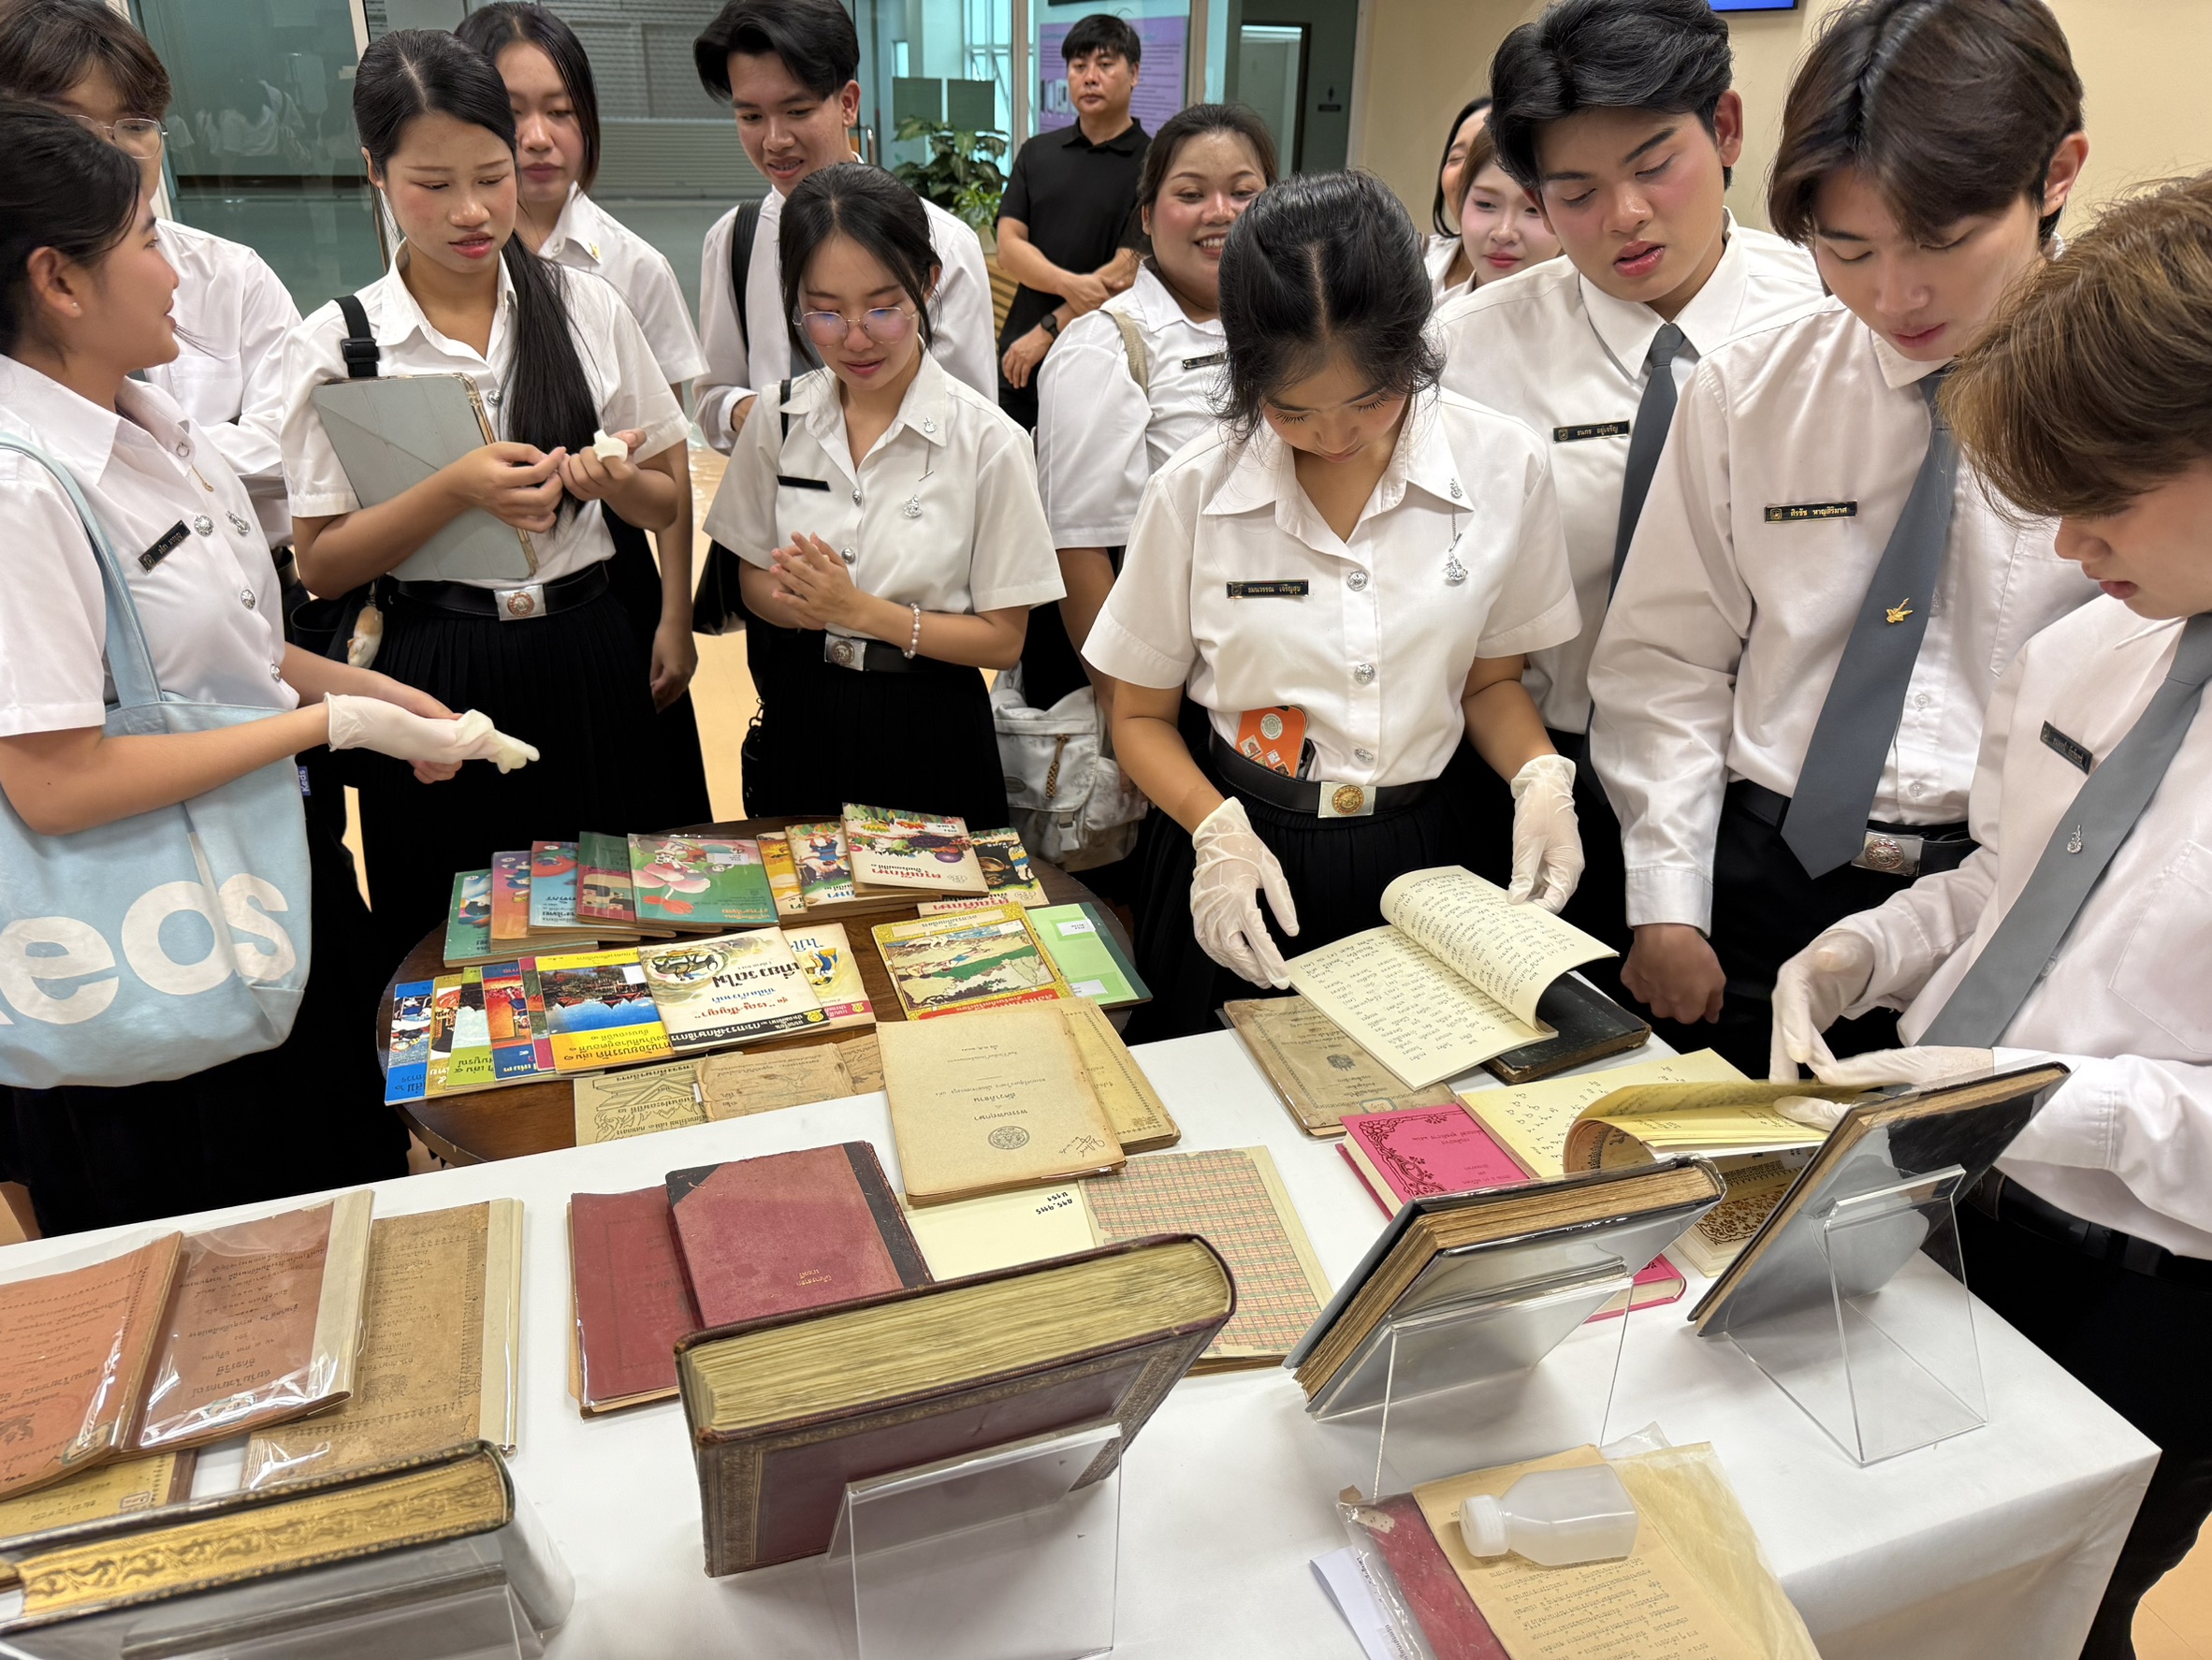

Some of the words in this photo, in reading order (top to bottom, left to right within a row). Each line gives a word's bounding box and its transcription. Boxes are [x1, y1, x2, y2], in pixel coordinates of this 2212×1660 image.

[0, 873, 297, 1025] eos
[670, 1023, 761, 1042] กระทรวงศึกษาธิการ
[575, 1052, 592, 1063] เล่ม
[466, 1065, 484, 1074] เล่ม
[973, 1109, 1027, 1121] พรรณพฤกษา
